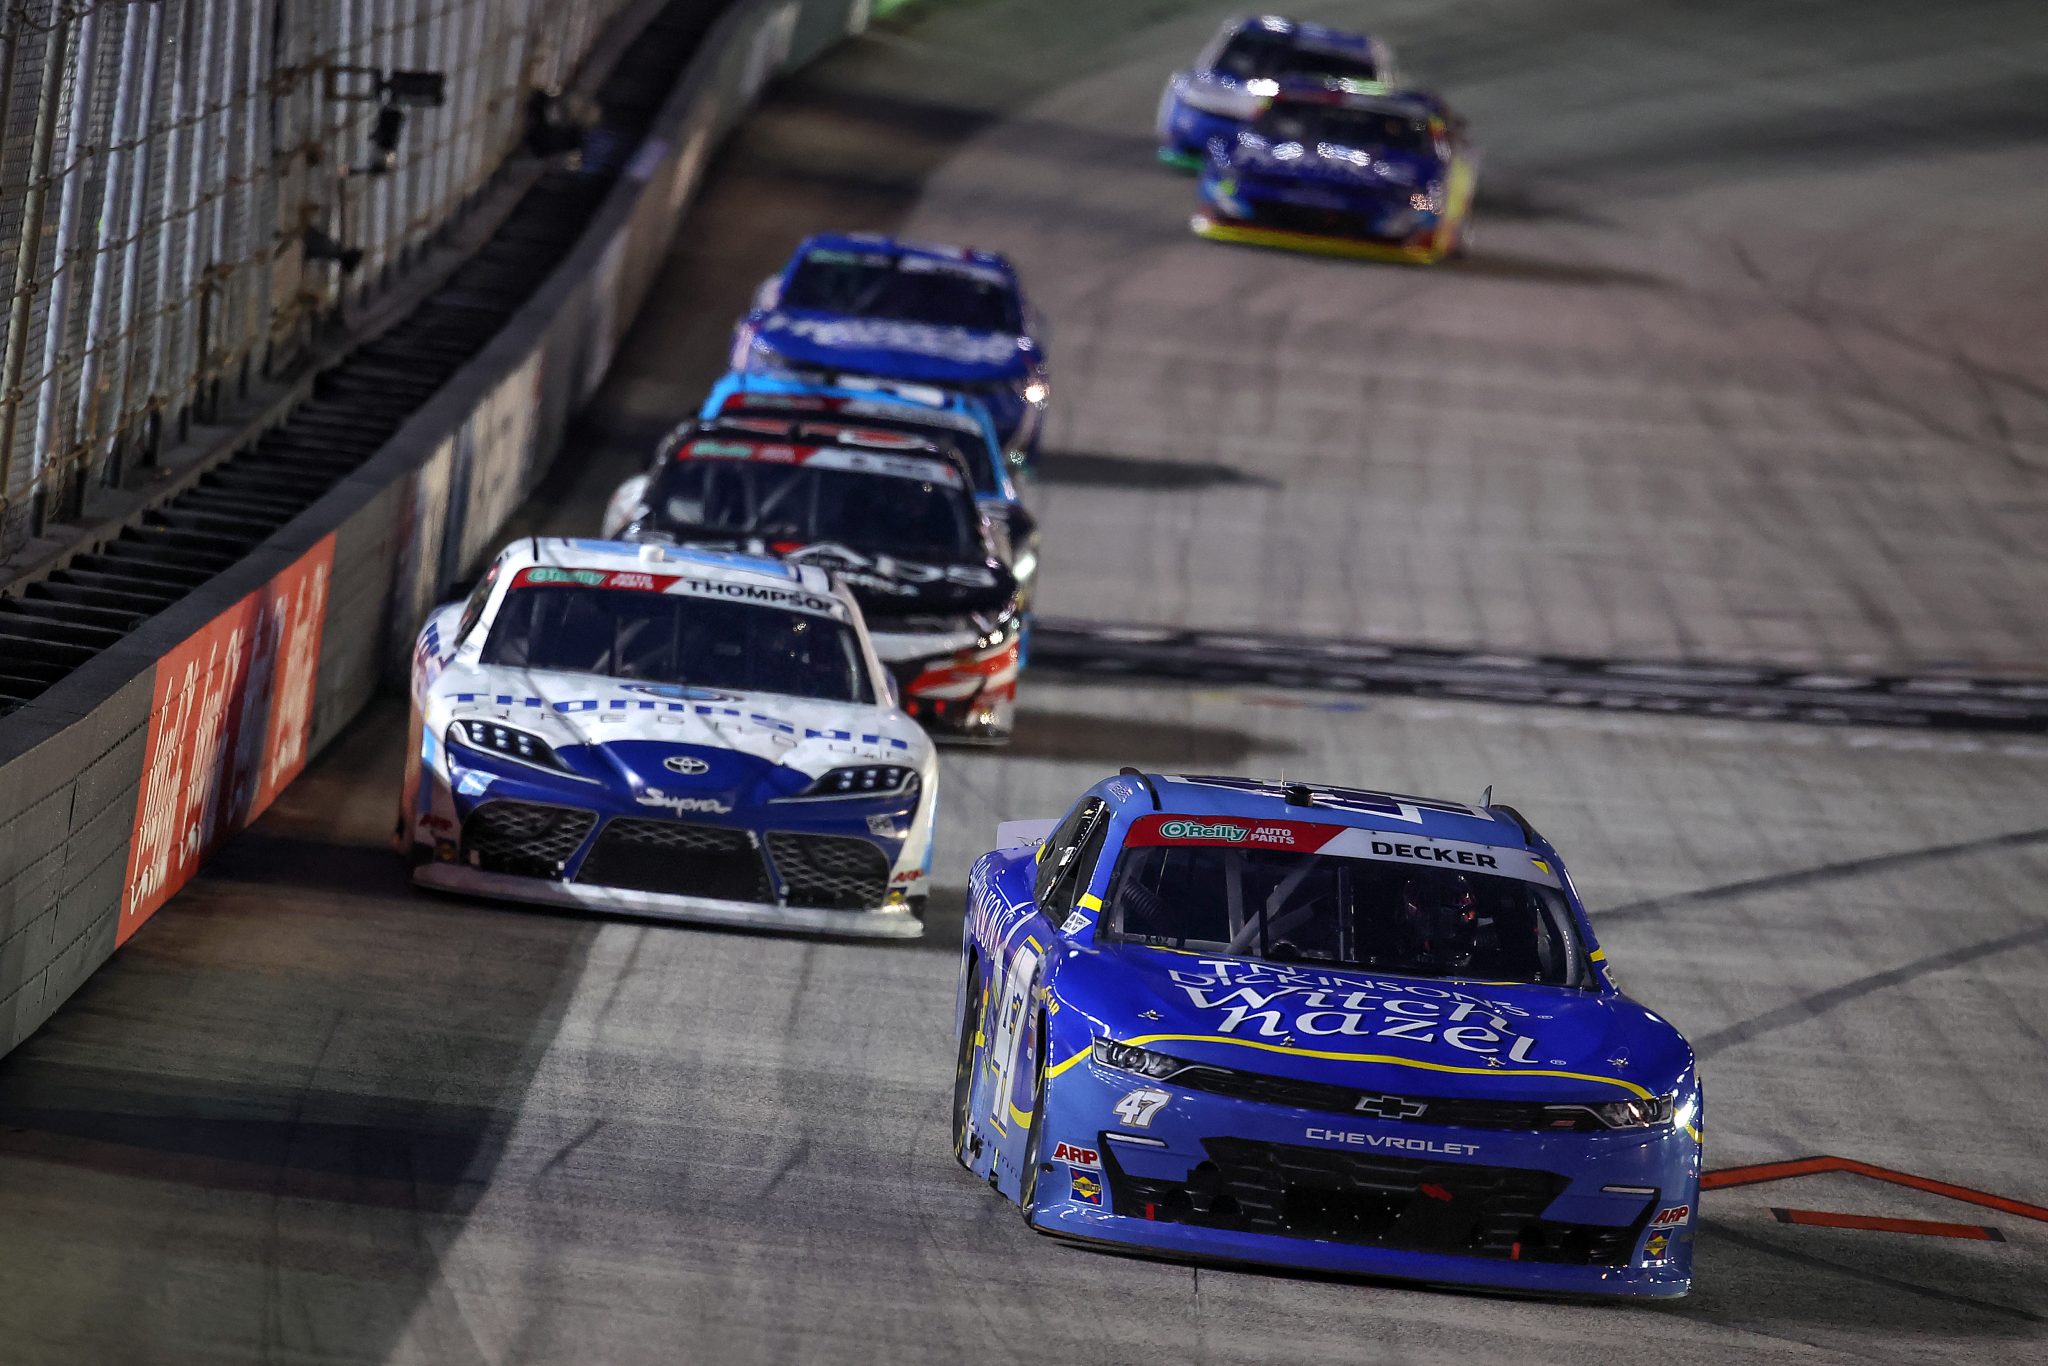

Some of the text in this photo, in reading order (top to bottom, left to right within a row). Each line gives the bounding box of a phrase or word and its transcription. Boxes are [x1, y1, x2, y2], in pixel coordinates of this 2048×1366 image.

[636, 787, 732, 818] Supra
[1160, 820, 1249, 841] O'Reilly
[1251, 834, 1295, 845] PARTS
[1255, 827, 1292, 837] AUTO
[1371, 841, 1498, 869] DECKER
[1168, 970, 1530, 1016] DICKINSON'S
[1175, 984, 1517, 1036] Witch
[1113, 1088, 1173, 1128] 47
[1054, 1143, 1098, 1165] ARP
[1306, 1127, 1480, 1156] CHEVROLET
